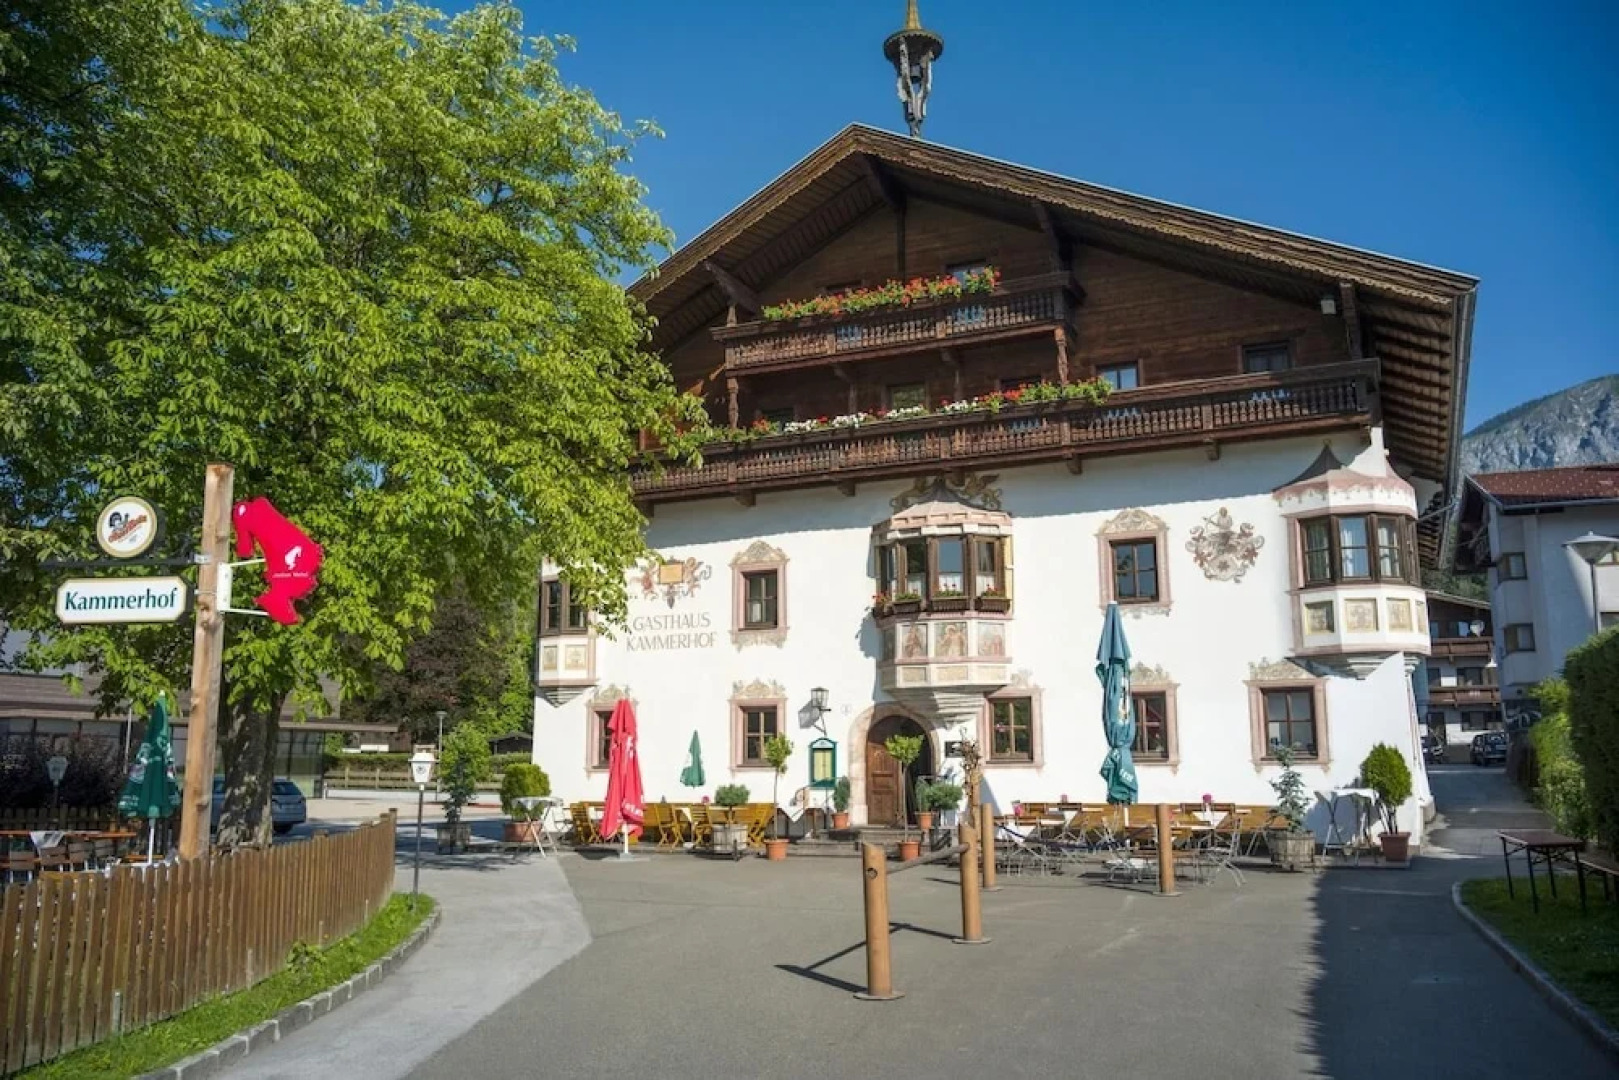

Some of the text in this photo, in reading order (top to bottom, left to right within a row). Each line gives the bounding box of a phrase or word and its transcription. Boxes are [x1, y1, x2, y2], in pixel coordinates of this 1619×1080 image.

[65, 587, 178, 611] Kammerhof
[633, 612, 711, 631] GASTHAUS
[626, 631, 717, 652] KAMMERHOF
